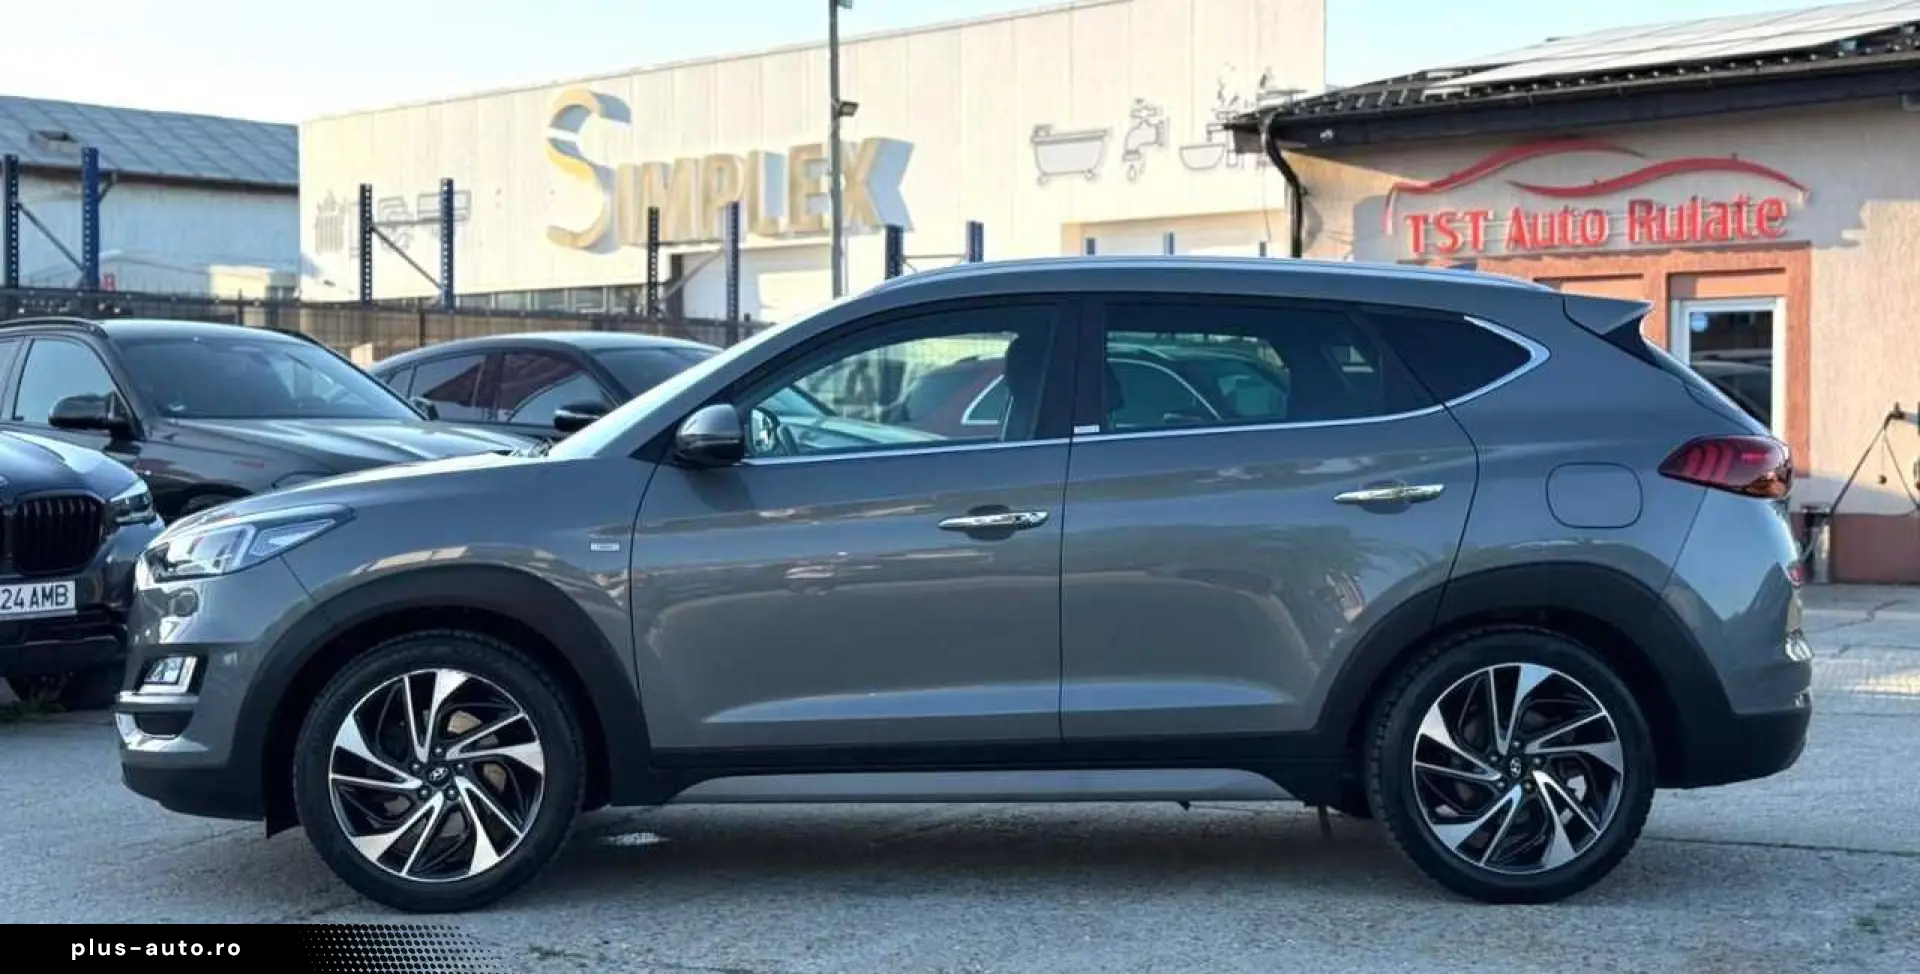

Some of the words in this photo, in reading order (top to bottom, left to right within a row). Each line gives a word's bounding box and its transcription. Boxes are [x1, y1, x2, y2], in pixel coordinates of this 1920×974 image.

[546, 88, 913, 252] SIMPLEX
[1406, 209, 1492, 255] TST
[1505, 205, 1608, 250] Auto
[1627, 194, 1787, 244] Rulate
[1, 587, 24, 610] 24
[29, 584, 69, 609] AMB
